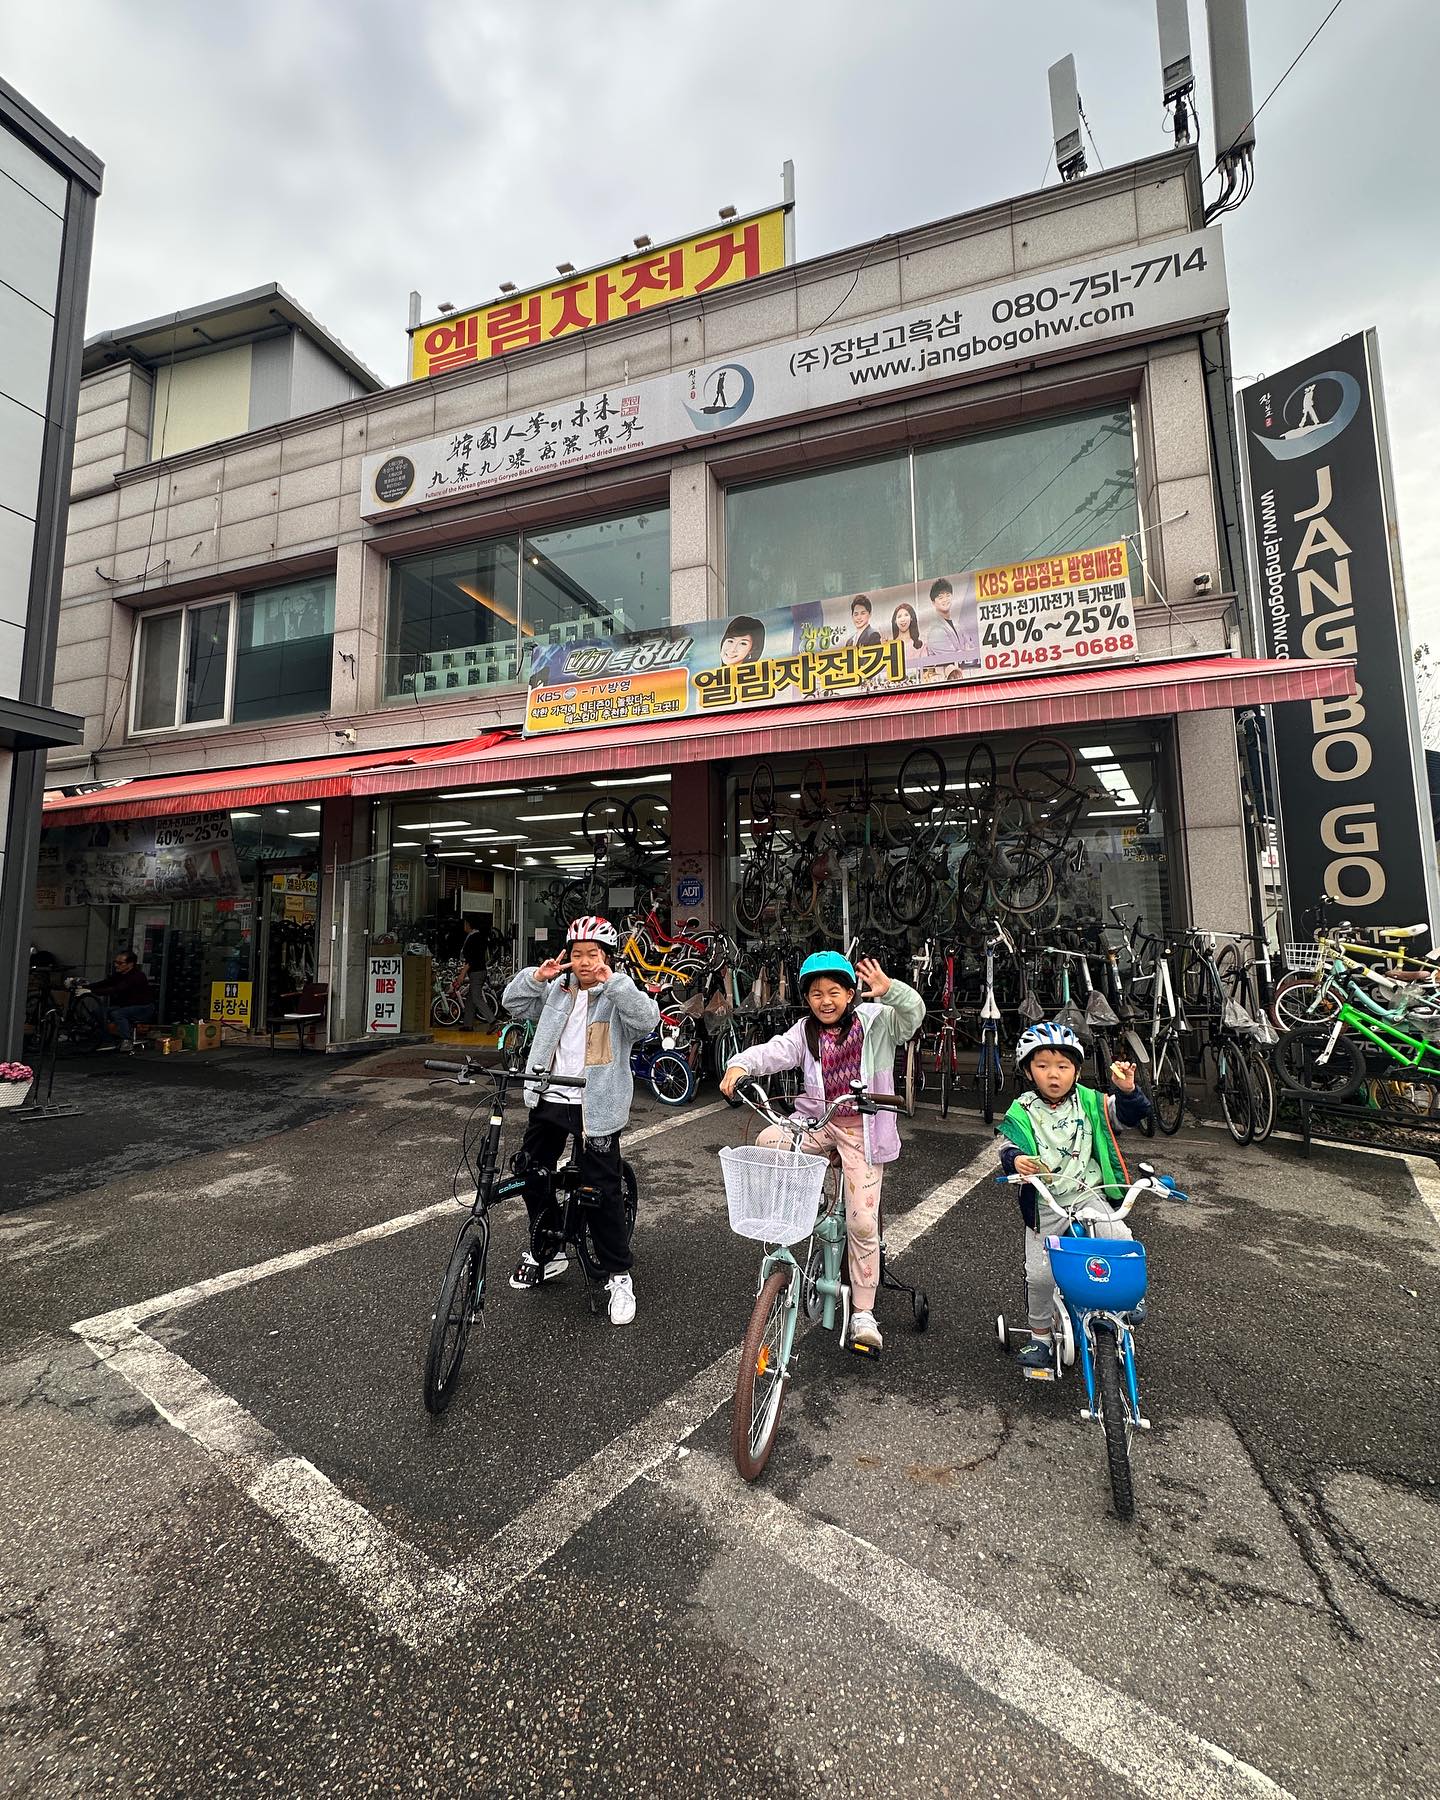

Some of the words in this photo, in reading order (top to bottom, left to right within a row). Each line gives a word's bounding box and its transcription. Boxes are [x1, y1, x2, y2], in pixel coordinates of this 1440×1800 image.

[424, 224, 760, 376] 엘림자전거
[789, 310, 963, 377] (주)장보고흑삼
[991, 246, 1208, 324] 080-751-7714
[849, 301, 1135, 386] www.jangbogohw.com
[425, 490, 443, 499] Future
[457, 482, 476, 491] Korean
[477, 477, 498, 488] ginseng
[498, 472, 518, 483] Goryeo
[519, 467, 534, 476] Black
[559, 455, 584, 466] steamed
[584, 452, 596, 460] and
[596, 447, 612, 457] dried
[613, 444, 626, 453] nine
[627, 440, 644, 450] times
[978, 570, 1009, 597] KBS
[1012, 560, 1065, 593] 생생정보
[1067, 547, 1122, 583] 방영매장
[1260, 489, 1290, 659] www.jangbogohw.co
[1292, 465, 1358, 658] JANG
[1078, 582, 1126, 605] 특가판매
[982, 603, 1130, 648] 40%~25%
[609, 637, 694, 672] 특공대
[985, 634, 1134, 670] 02)483-0688
[694, 640, 905, 706] 엘림자전거
[536, 691, 562, 704] KBS
[551, 703, 576, 716] 가격에
[580, 697, 613, 712] 네티즌이
[602, 707, 629, 720] 추천한
[632, 703, 650, 716] 바로
[653, 699, 680, 713] 그곳!!
[156, 822, 229, 846] 40%~25%
[1320, 803, 1386, 907] GO
[286, 878, 318, 894] 엘림자전
[681, 886, 700, 897] ADT
[371, 959, 401, 975] 자전거
[375, 978, 396, 993] 매장
[212, 999, 248, 1016] 화장실
[375, 1003, 395, 1018] 입구
